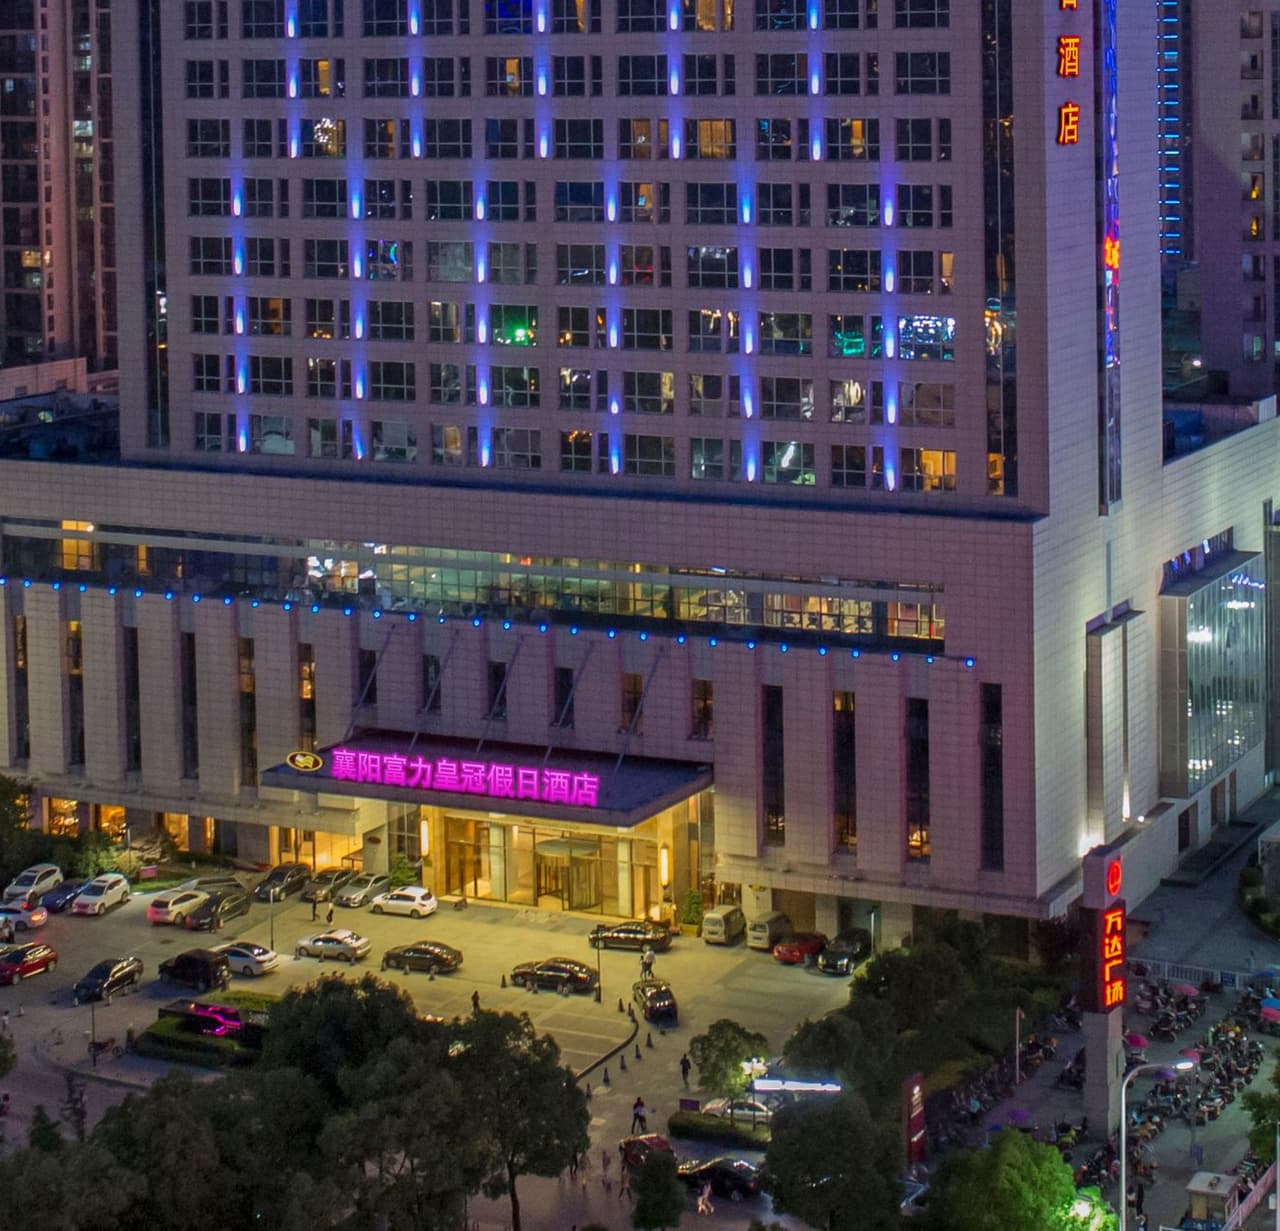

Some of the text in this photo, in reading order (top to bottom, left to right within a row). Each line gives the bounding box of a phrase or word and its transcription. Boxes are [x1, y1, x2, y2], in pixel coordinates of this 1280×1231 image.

[332, 748, 600, 807] 襄阳富力皇冠假日酒店
[1104, 911, 1124, 1007] 万达广场
